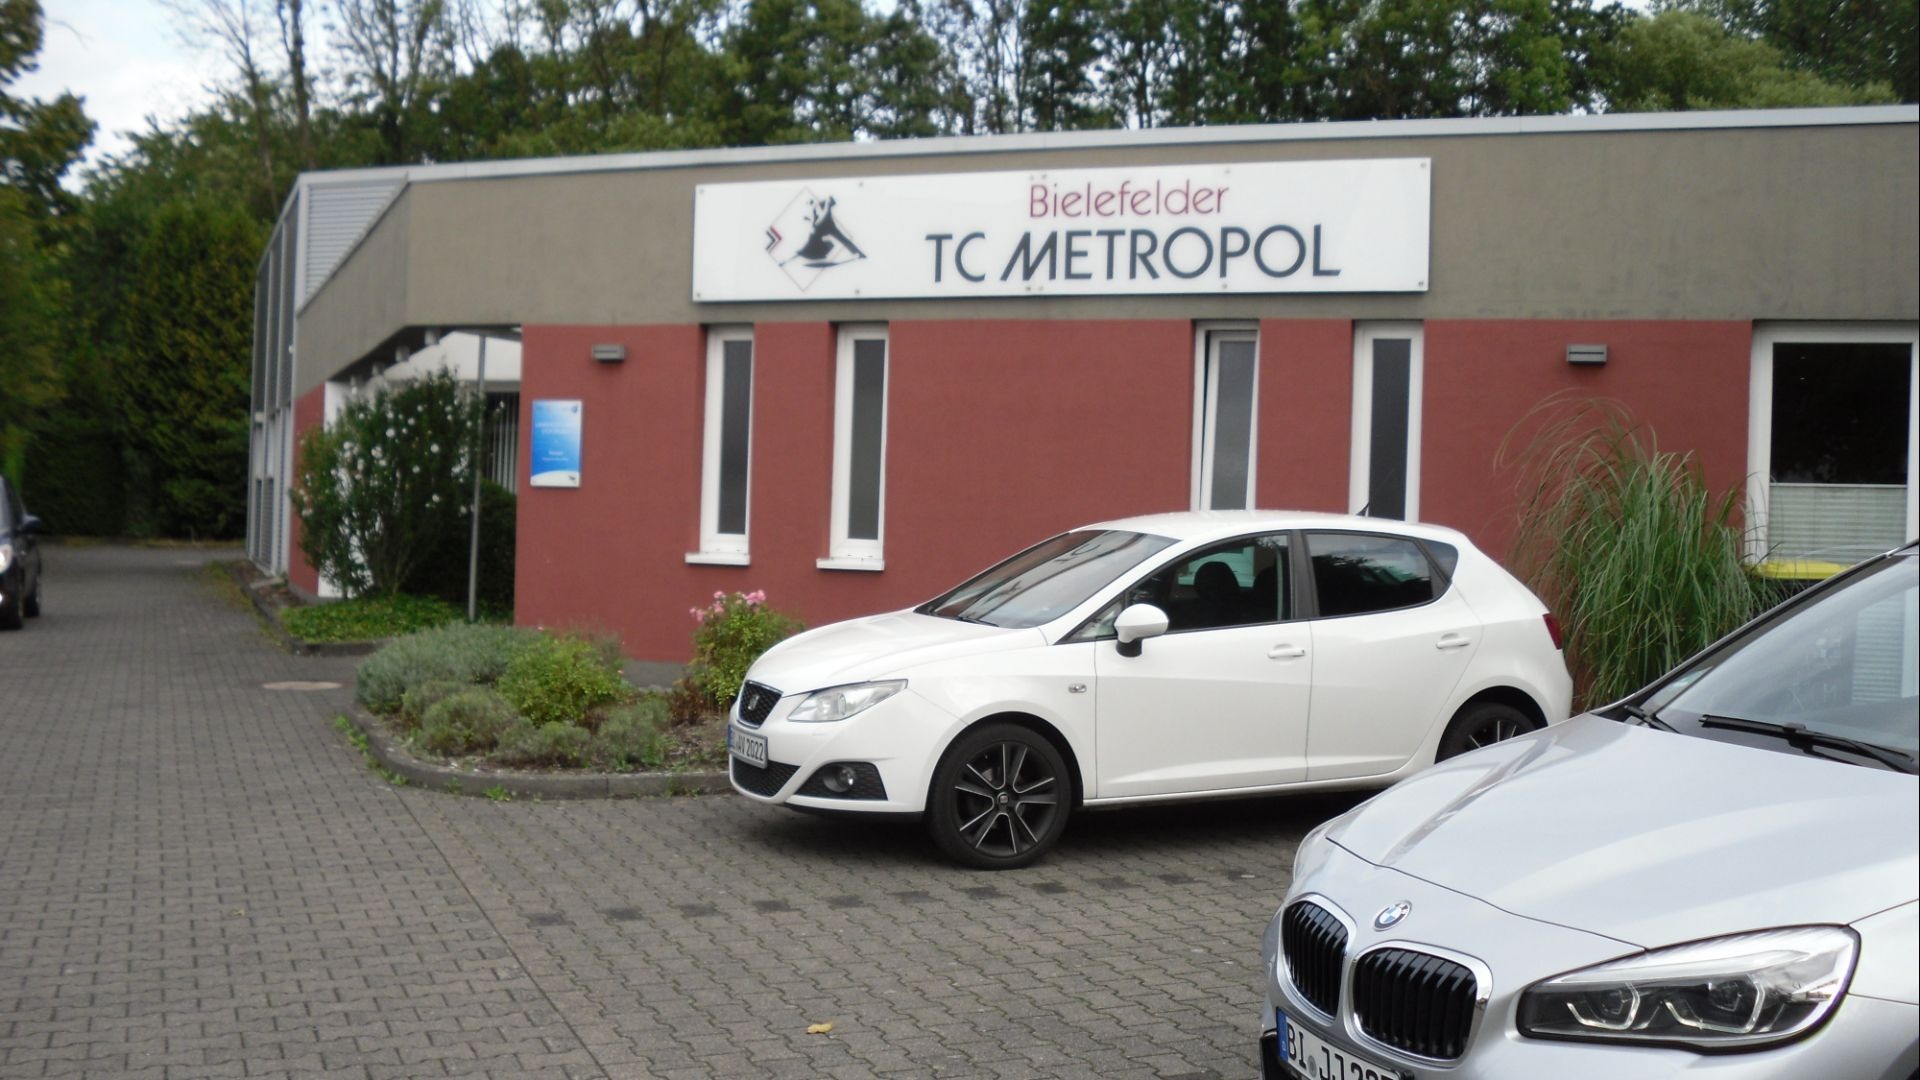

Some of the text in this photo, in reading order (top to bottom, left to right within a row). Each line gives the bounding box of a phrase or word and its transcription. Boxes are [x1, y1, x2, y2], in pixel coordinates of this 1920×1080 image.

[1029, 179, 1229, 217] Bielefelder
[925, 224, 1341, 283] TC METROPOL
[746, 738, 764, 761] 2022
[1286, 1022, 1307, 1070] BI
